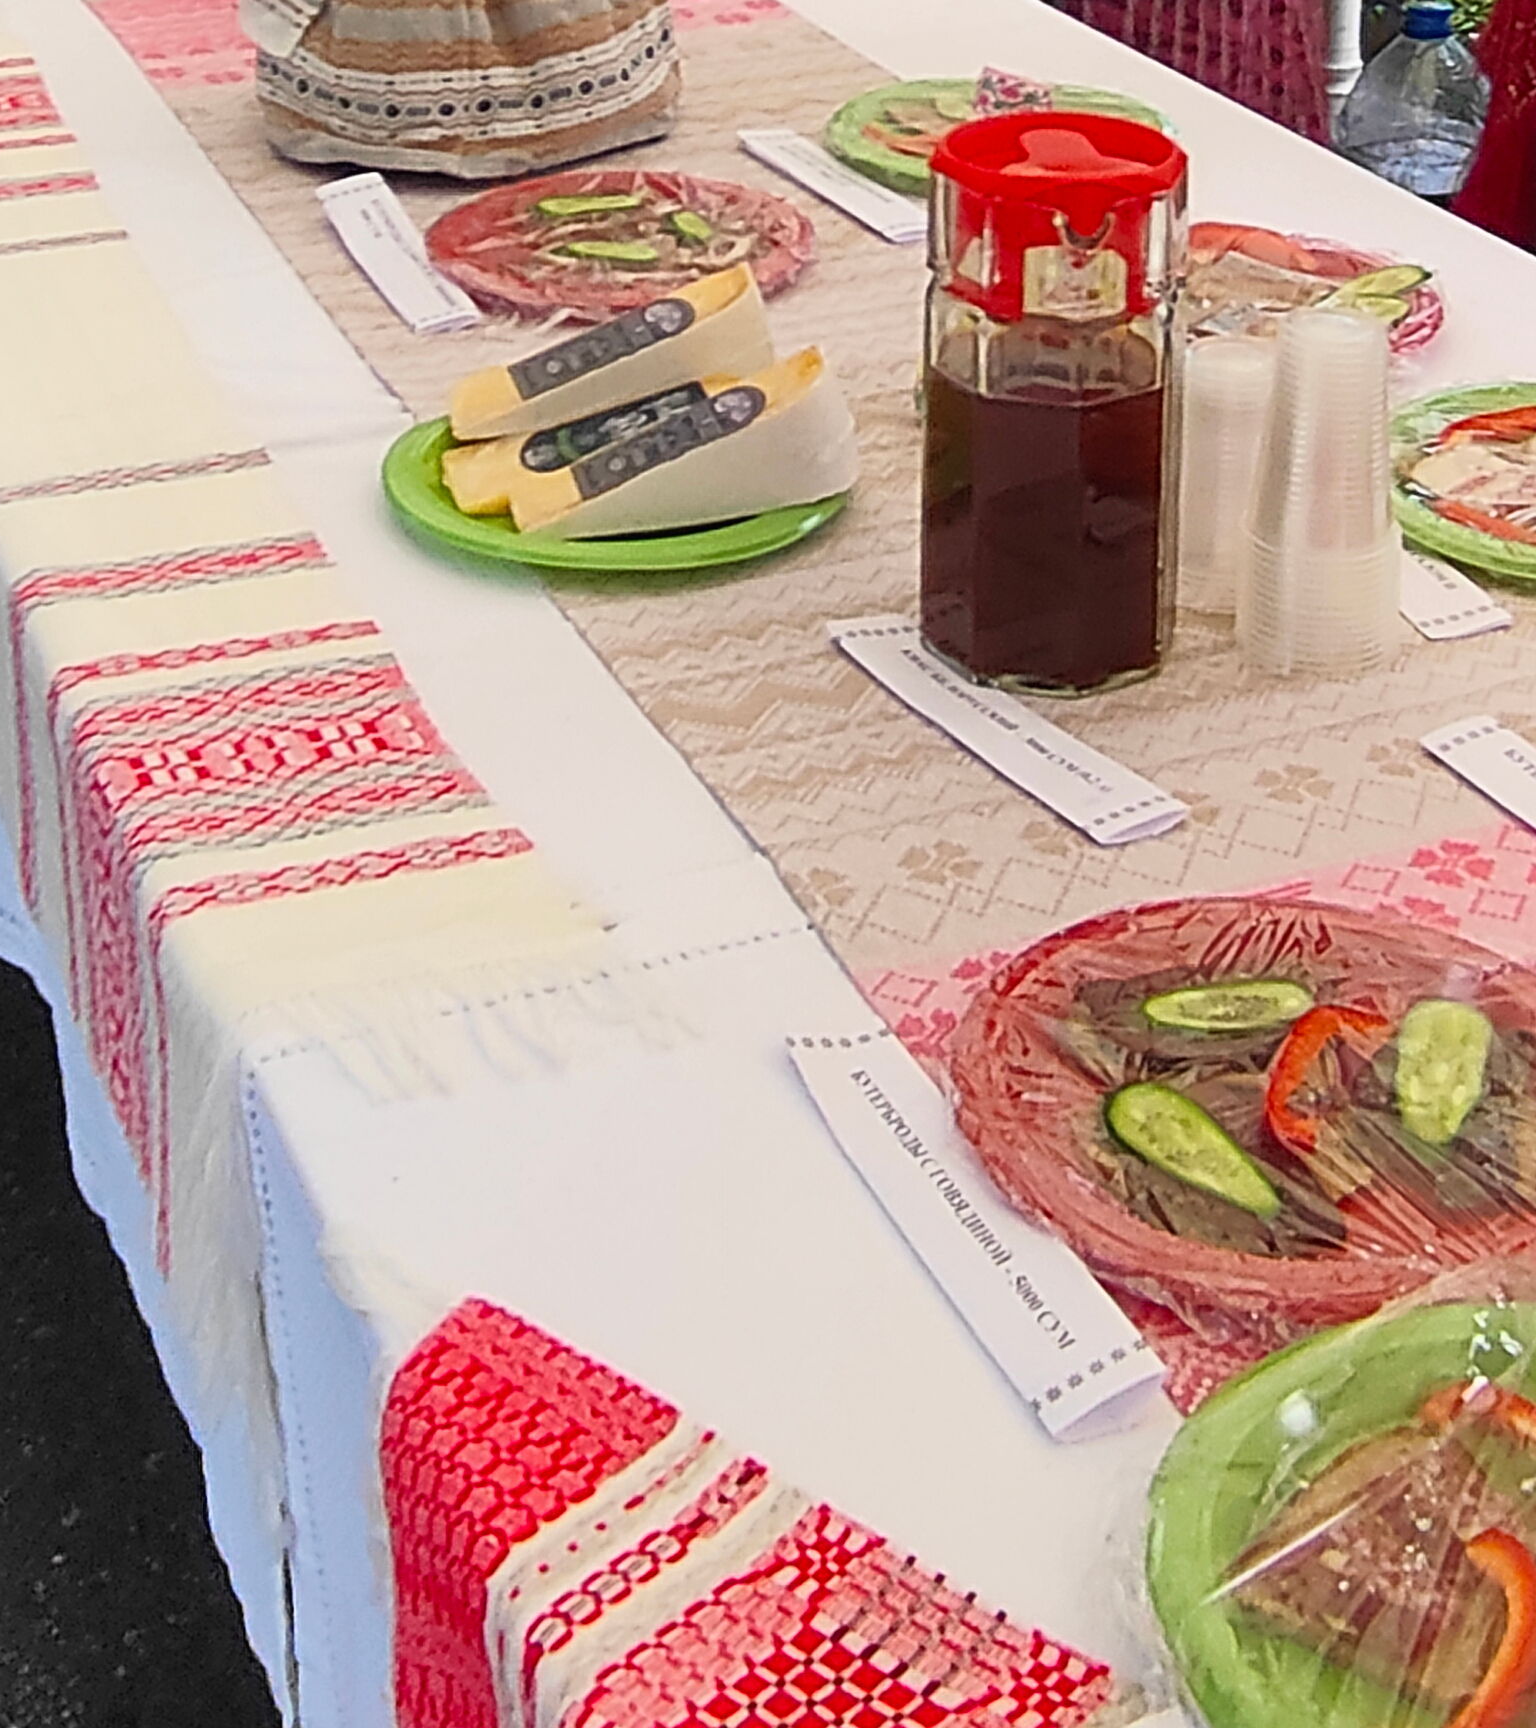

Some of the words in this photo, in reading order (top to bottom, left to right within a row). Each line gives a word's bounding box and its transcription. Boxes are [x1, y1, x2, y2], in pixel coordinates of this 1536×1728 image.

[850, 1069, 928, 1159] БУТЕРБРОДЫ
[929, 1168, 1013, 1266] ГОВЯДИНОЙ
[1014, 1274, 1045, 1311] 5000
